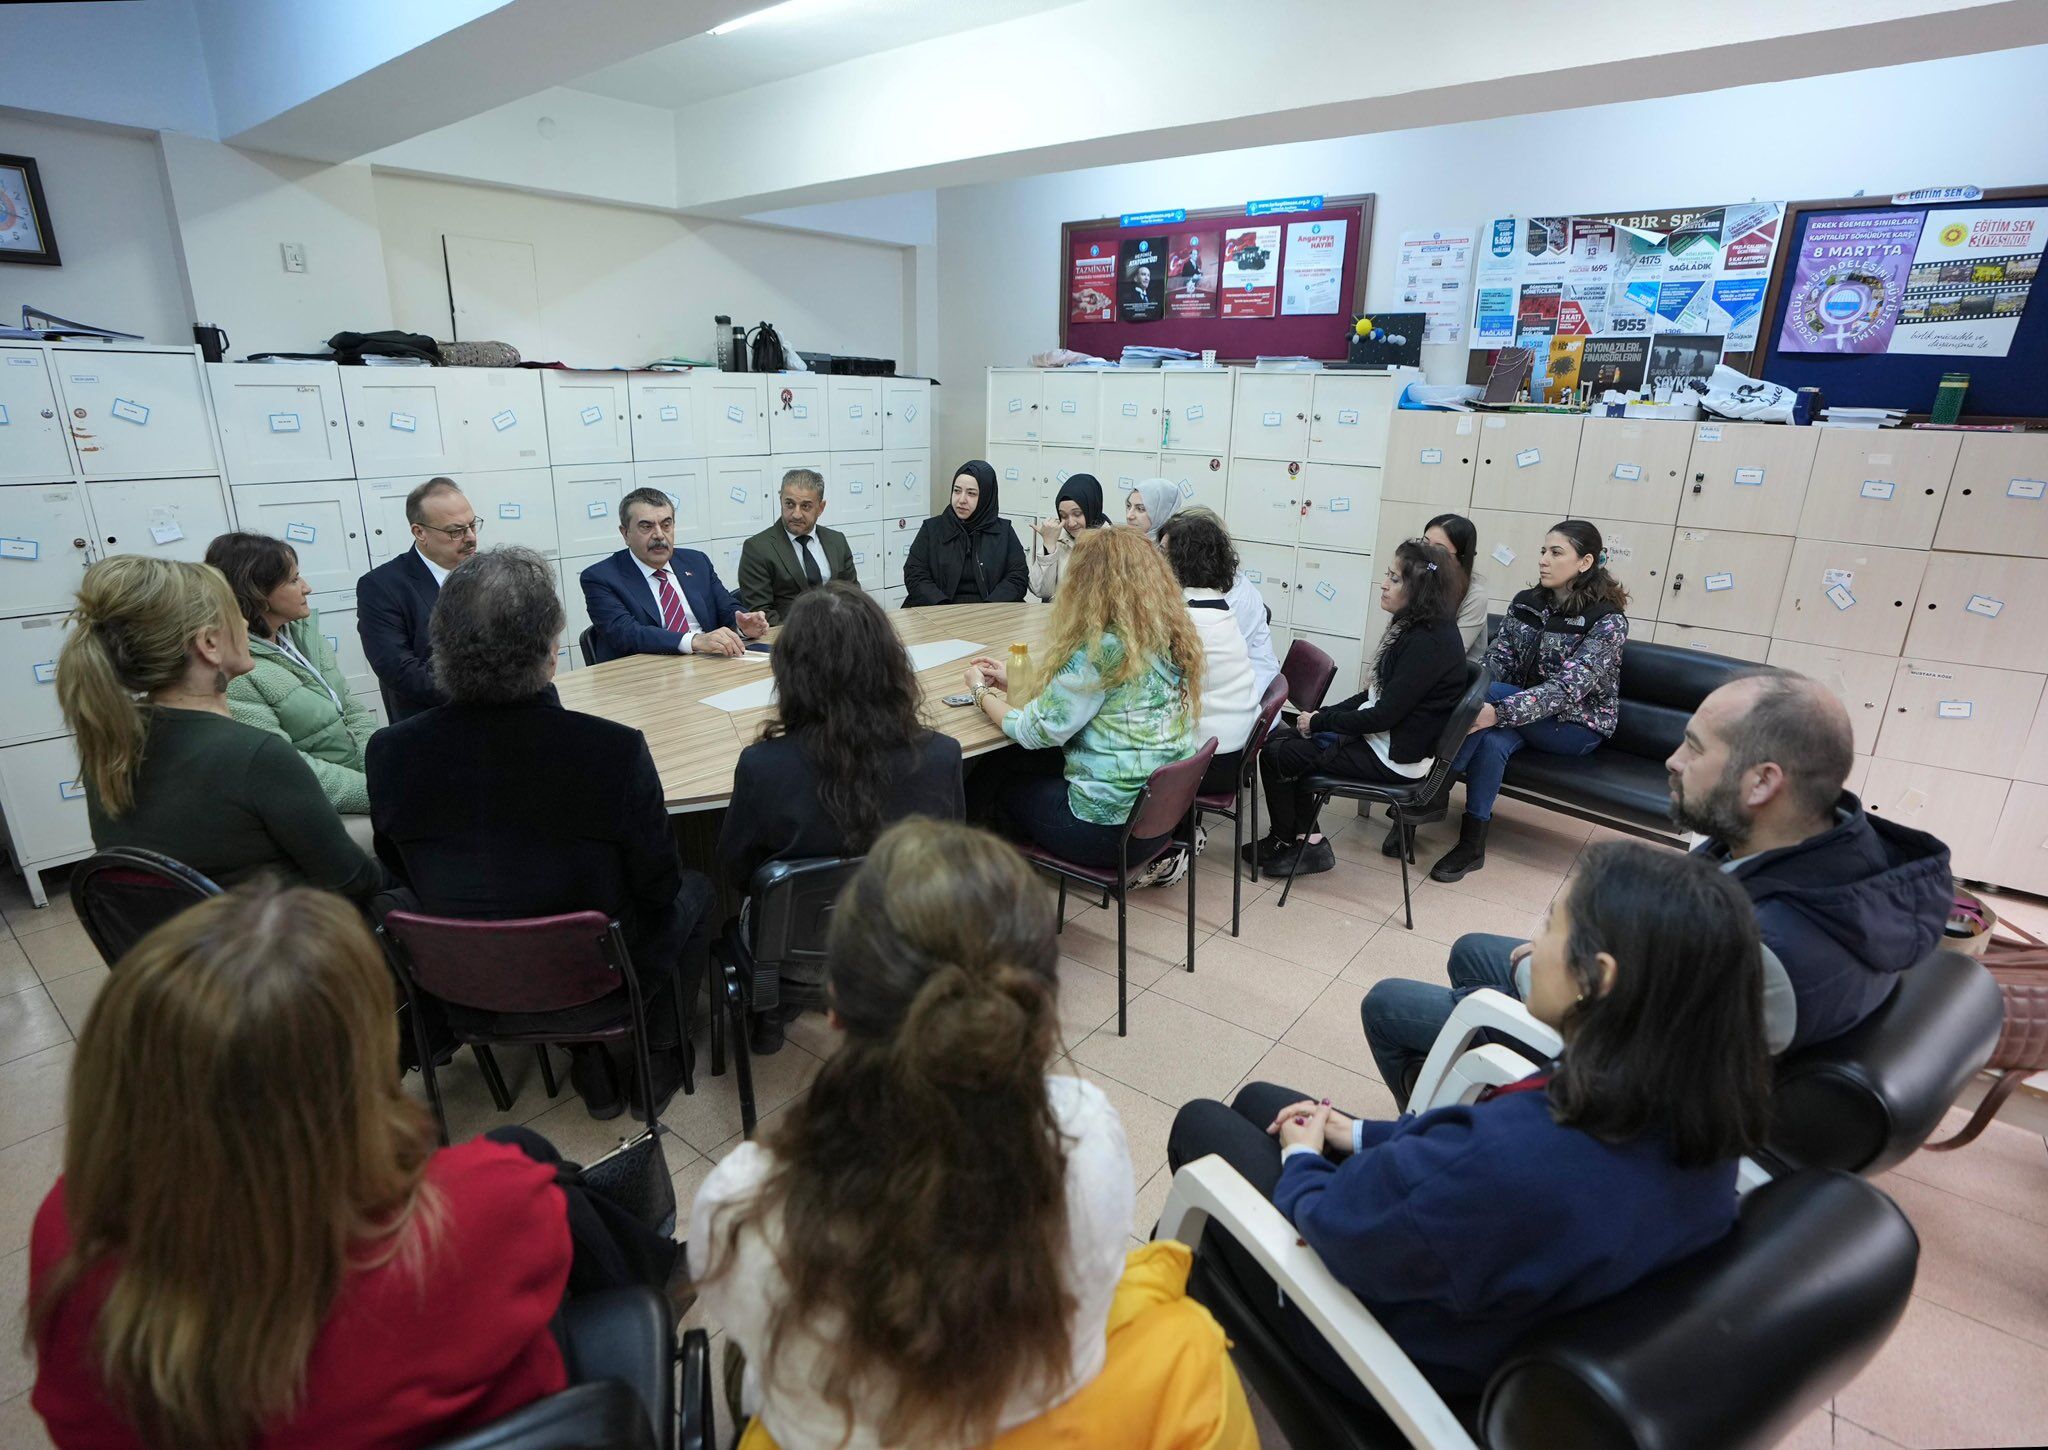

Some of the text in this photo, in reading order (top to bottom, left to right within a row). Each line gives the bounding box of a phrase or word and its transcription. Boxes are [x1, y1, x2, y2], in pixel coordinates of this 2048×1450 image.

[1943, 188, 1963, 198] SEN
[1629, 214, 1660, 229] BİR
[1811, 218, 1919, 229] ERKEK EGEMEN SINIRLARA
[1973, 219, 2035, 233] EĞİTİM SEN
[13, 231, 20, 240] 5
[1297, 235, 1335, 243] Angaryaya
[1808, 231, 1916, 242] KAPİTALİST SÖMÜRÜYE KARŞI
[1587, 247, 1597, 256] 13
[1813, 244, 1902, 258] 8 MART'TA
[1639, 255, 1661, 265] 4175
[1668, 262, 1711, 272] SAĞLADIK
[1803, 259, 1890, 291] MÜCADELESİNİ
[1853, 280, 1900, 344] BÜYÜTELİM!
[1790, 292, 1819, 346] ÖZGÜRLÜK
[1611, 318, 1647, 332] 1955
[1584, 342, 1640, 353] SİYONAZİLERİ
[1583, 352, 1642, 362] FİNANSÖRLERİNİ
[1911, 670, 1936, 678] MUSTAFA
